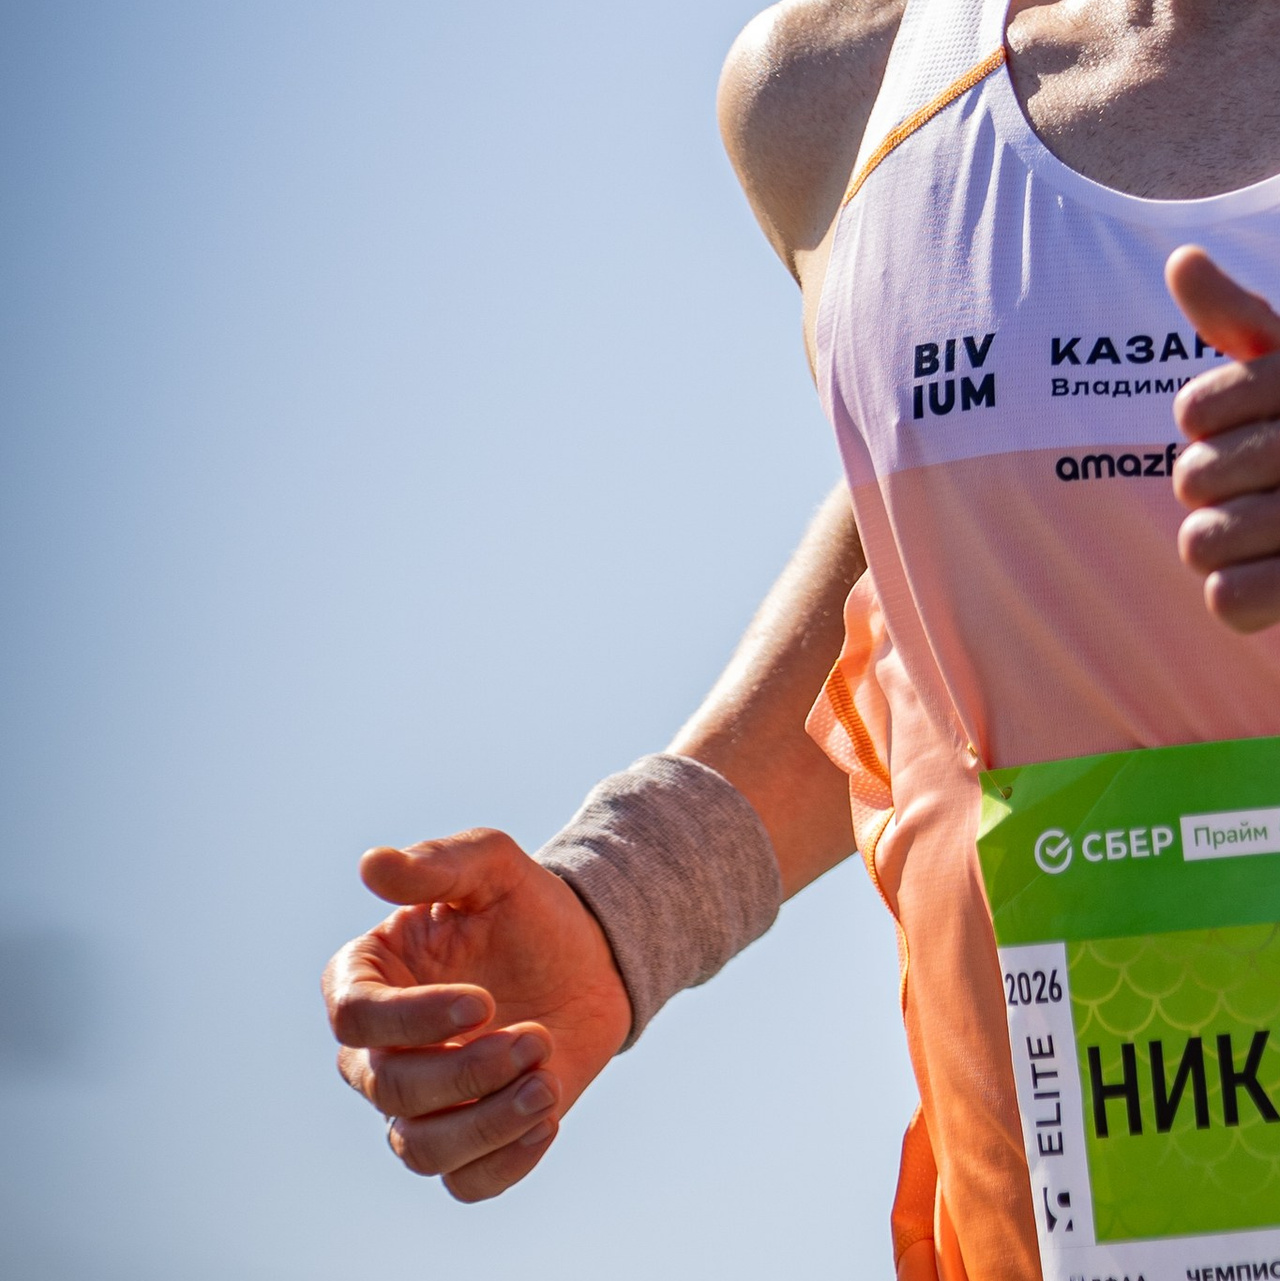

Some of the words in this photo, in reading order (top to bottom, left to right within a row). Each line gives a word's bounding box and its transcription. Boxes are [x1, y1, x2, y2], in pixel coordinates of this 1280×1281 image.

[914, 333, 996, 378] BIV
[1051, 331, 1224, 366] КАЗАН
[913, 372, 996, 420] IUM
[1055, 443, 1182, 482] amazf
[1081, 826, 1174, 862] СБЕР
[1193, 821, 1269, 850] Прайм
[1004, 970, 1063, 1006] 2026
[1026, 1034, 1064, 1157] ELITE
